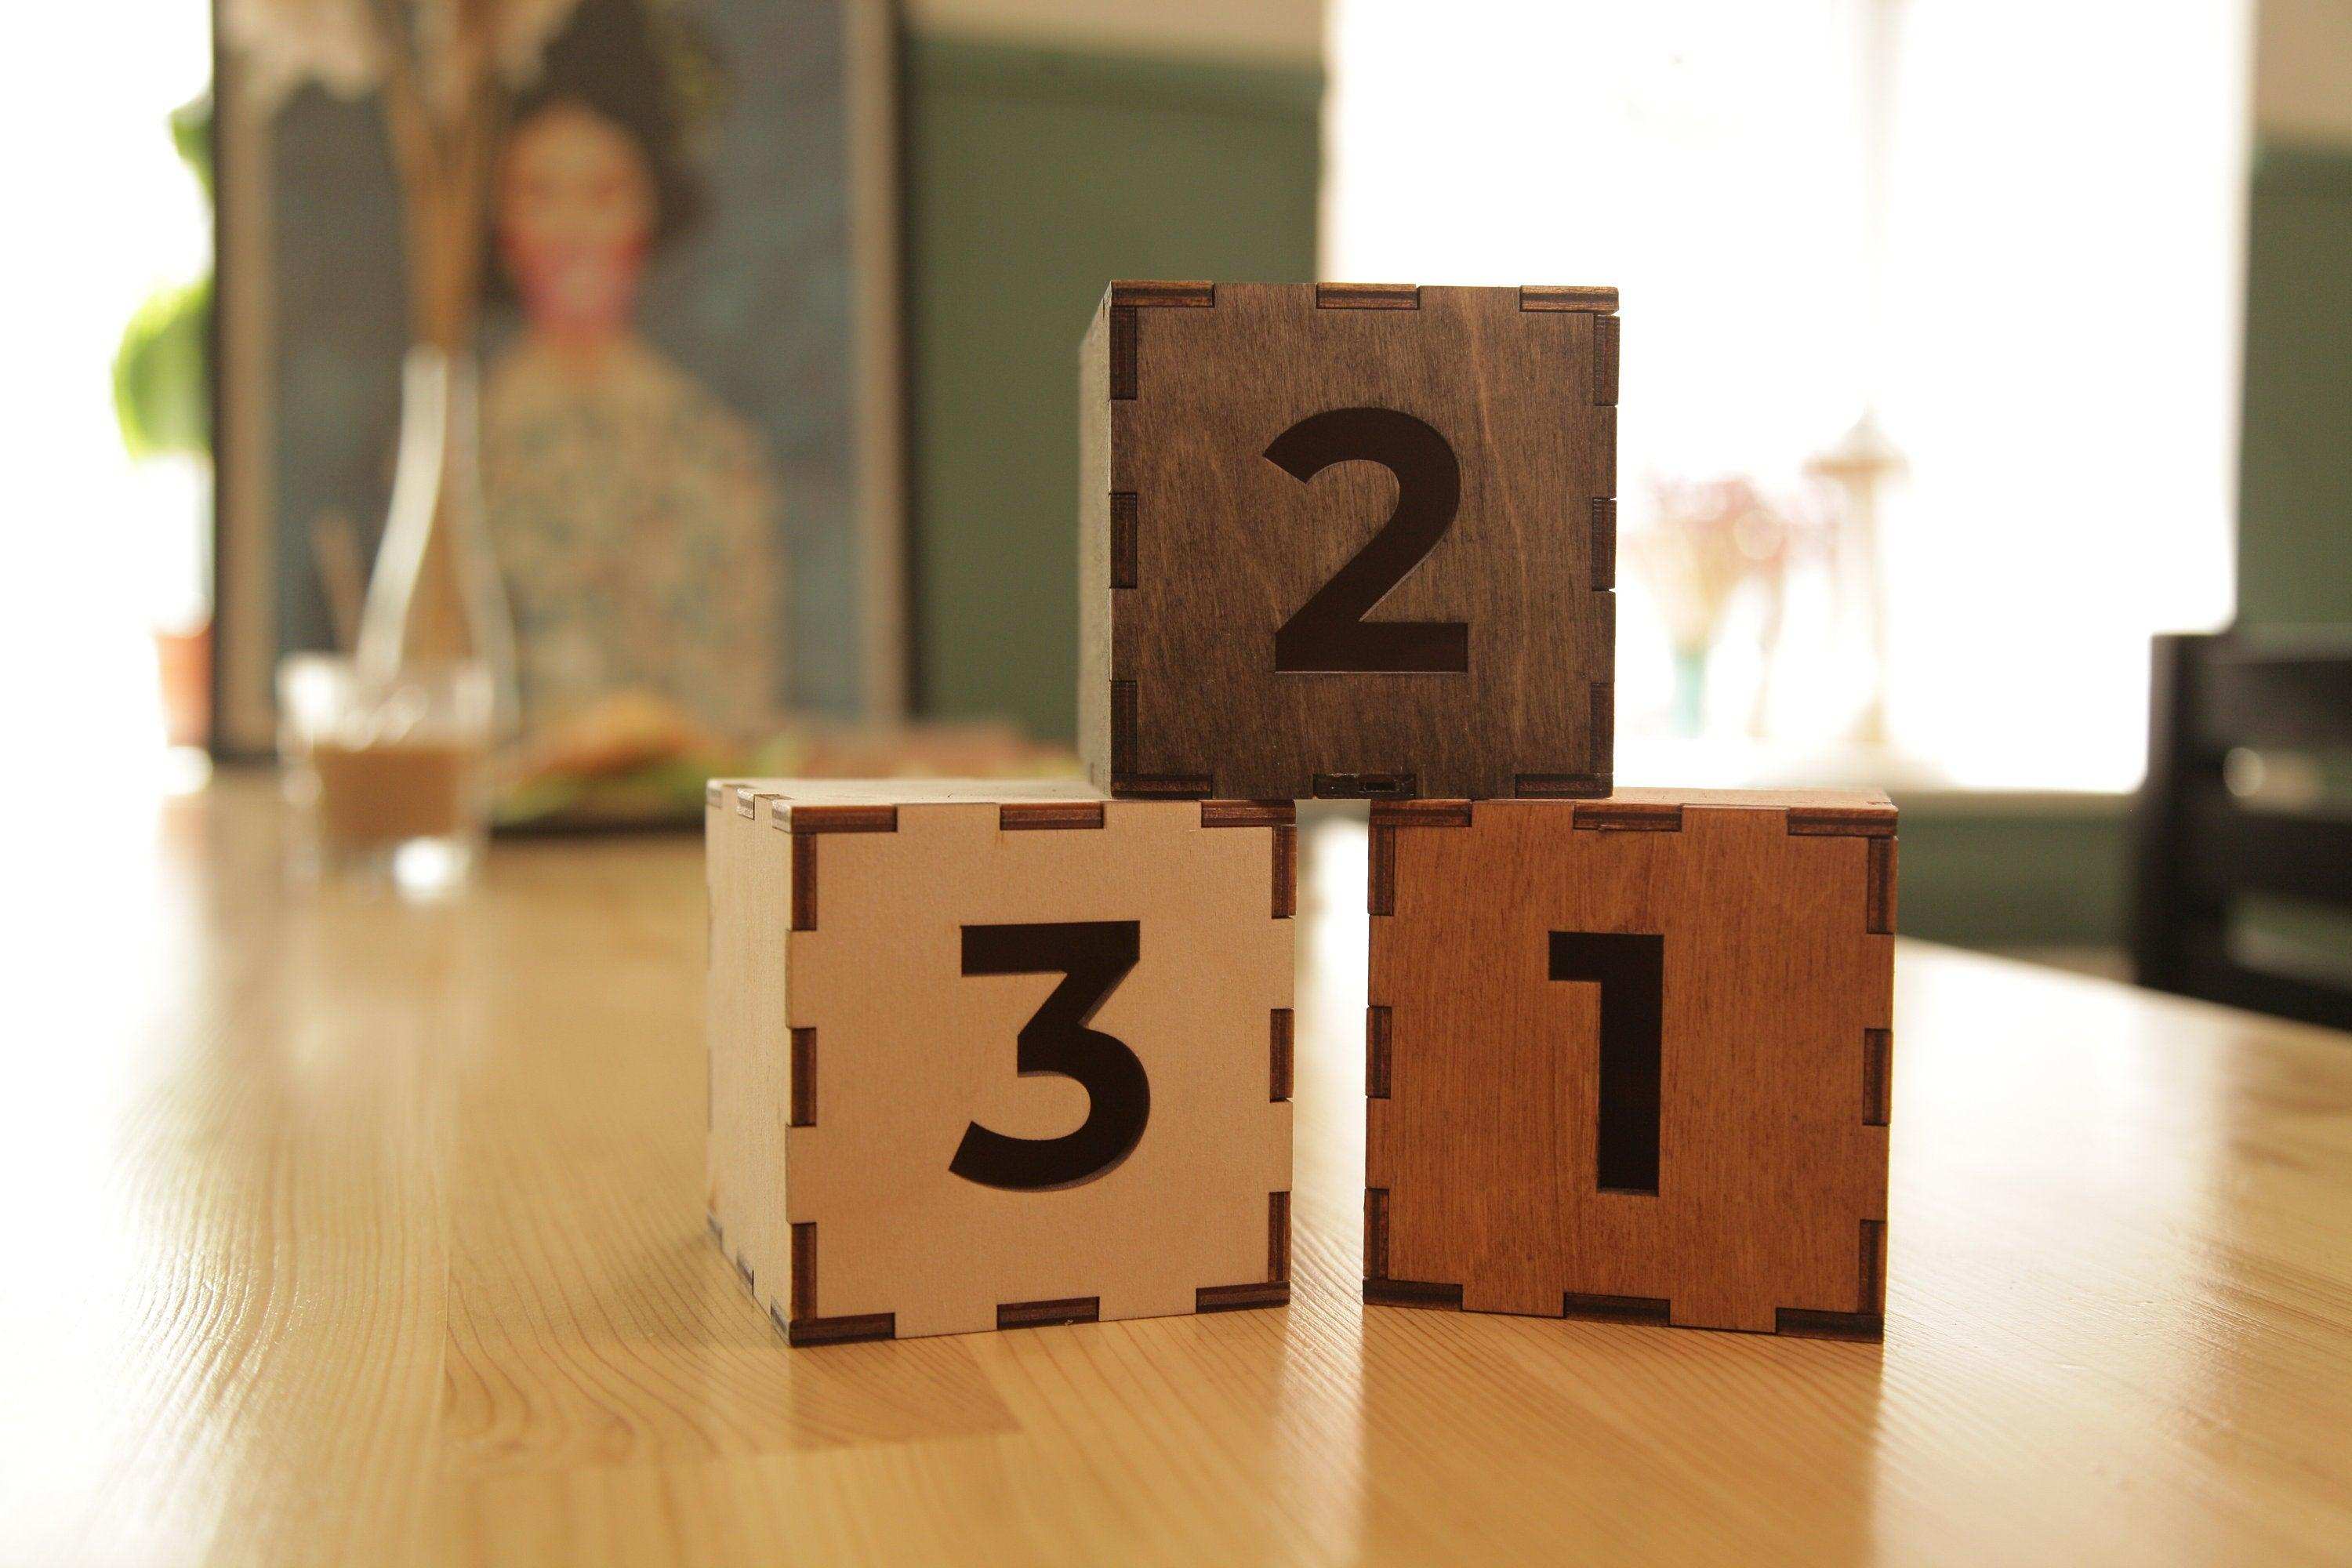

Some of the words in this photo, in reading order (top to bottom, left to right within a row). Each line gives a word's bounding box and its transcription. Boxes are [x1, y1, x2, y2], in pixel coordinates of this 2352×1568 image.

[1261, 406, 1469, 673] 2
[949, 920, 1151, 1192] 3
[1548, 931, 1664, 1197] 1
